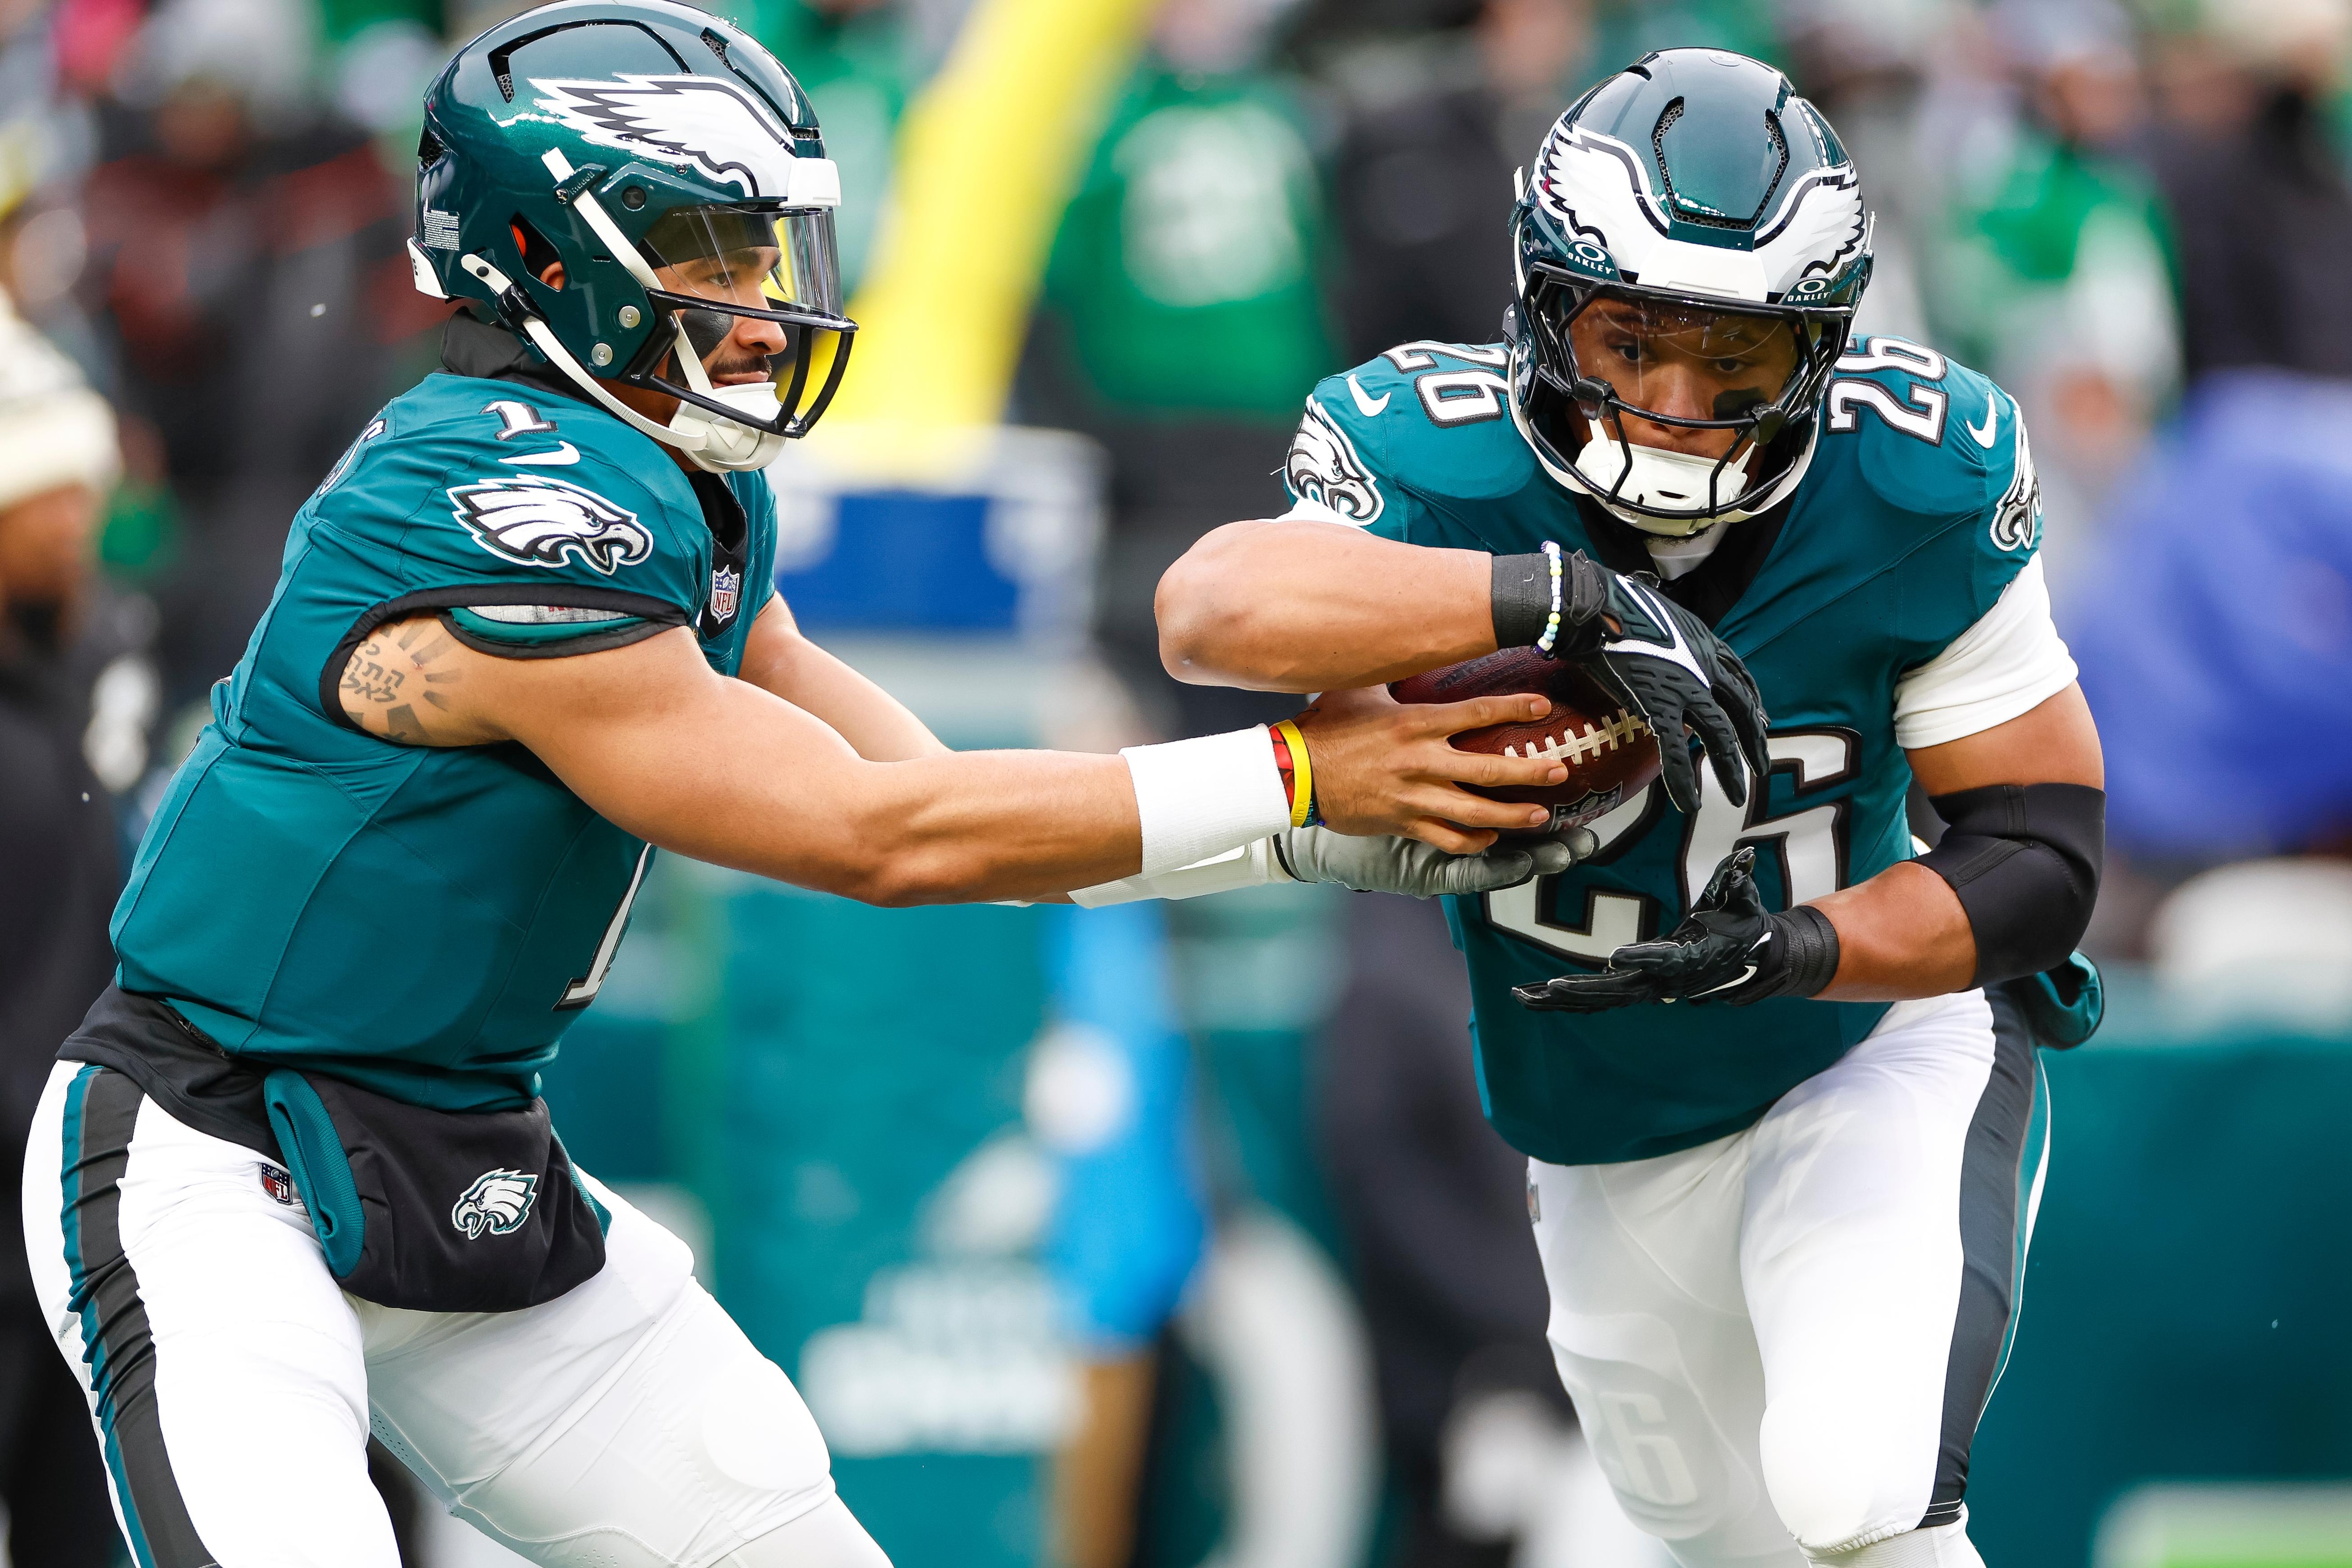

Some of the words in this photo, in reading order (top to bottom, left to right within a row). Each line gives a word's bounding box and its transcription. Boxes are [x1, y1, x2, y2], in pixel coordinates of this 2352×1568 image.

[1567, 252, 1612, 274] OAKLEY
[1787, 292, 1828, 302] OAKLEY
[1378, 341, 1510, 428] 26
[1826, 335, 1950, 448] 26
[478, 400, 558, 441] 1
[715, 592, 732, 613] NFL
[264, 1176, 287, 1200] NFL
